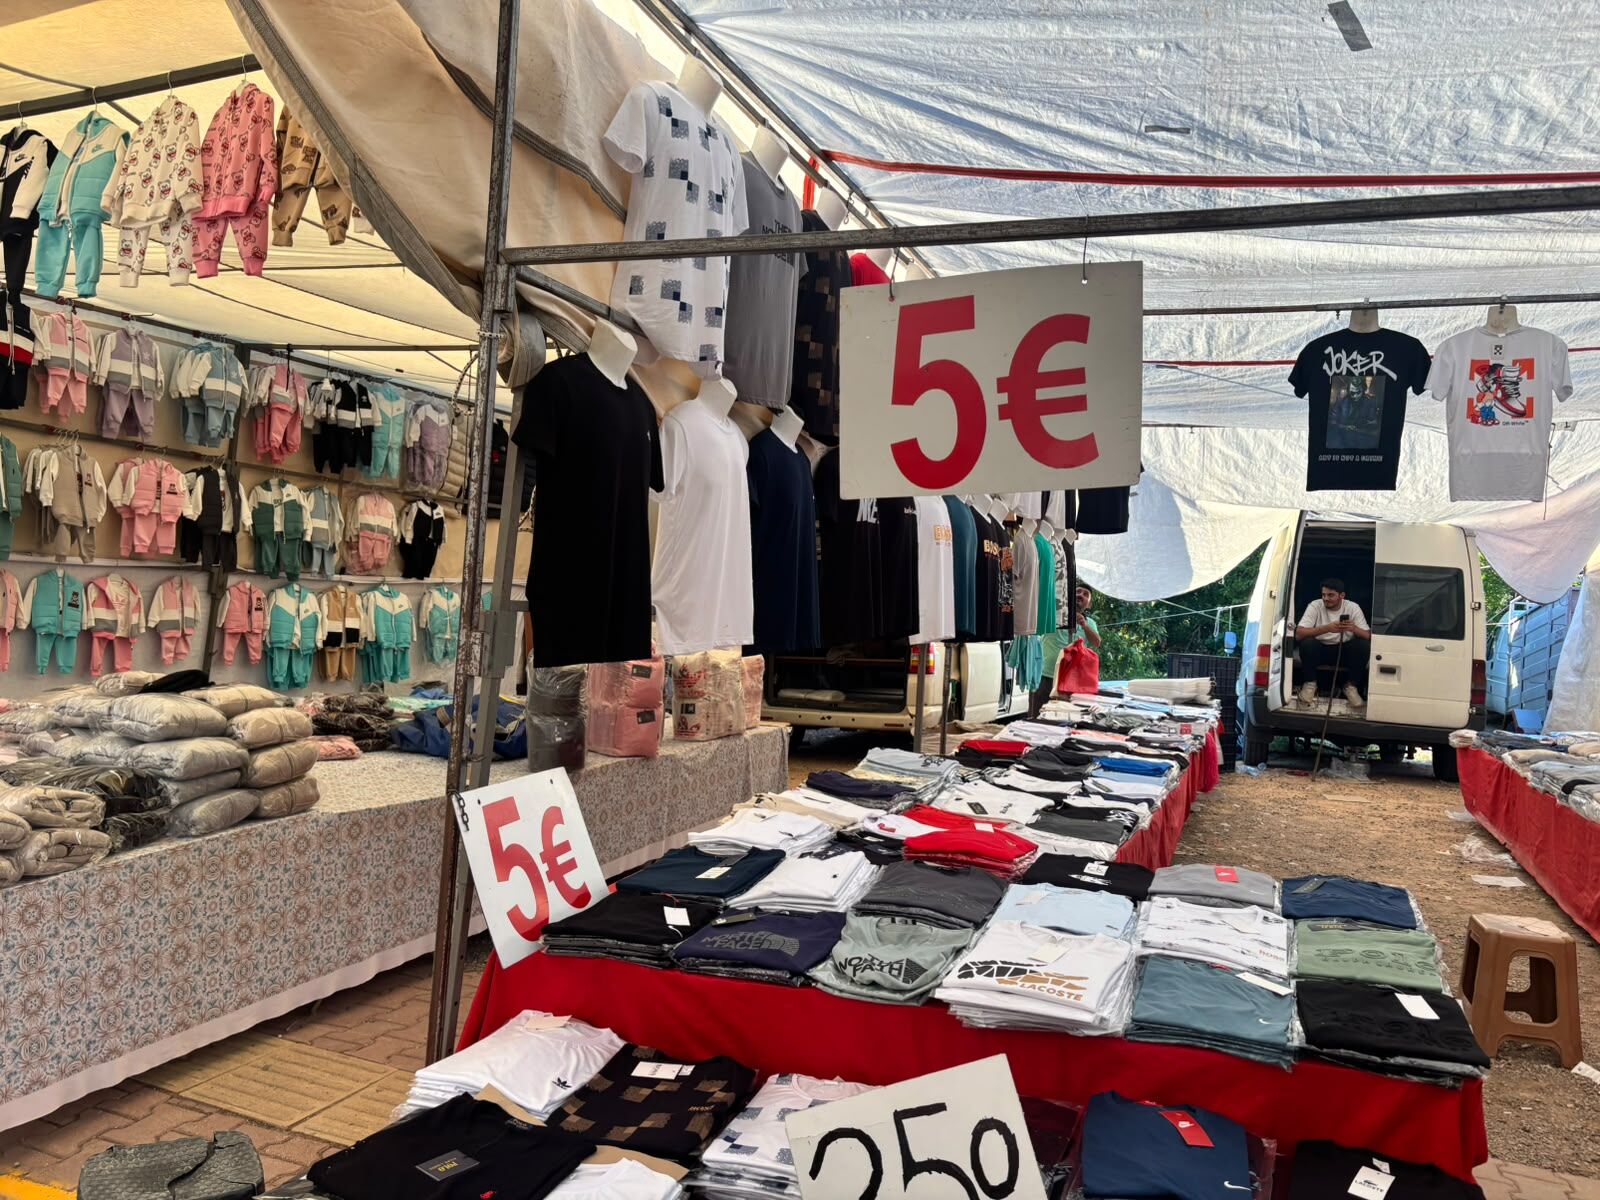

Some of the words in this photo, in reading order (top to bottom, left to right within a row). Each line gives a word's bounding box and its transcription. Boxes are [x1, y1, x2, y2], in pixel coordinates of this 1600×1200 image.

[890, 295, 1100, 490] 5€
[1322, 346, 1398, 382] JOKER
[482, 796, 592, 942] 5€
[1020, 983, 1084, 1002] LACOSTE
